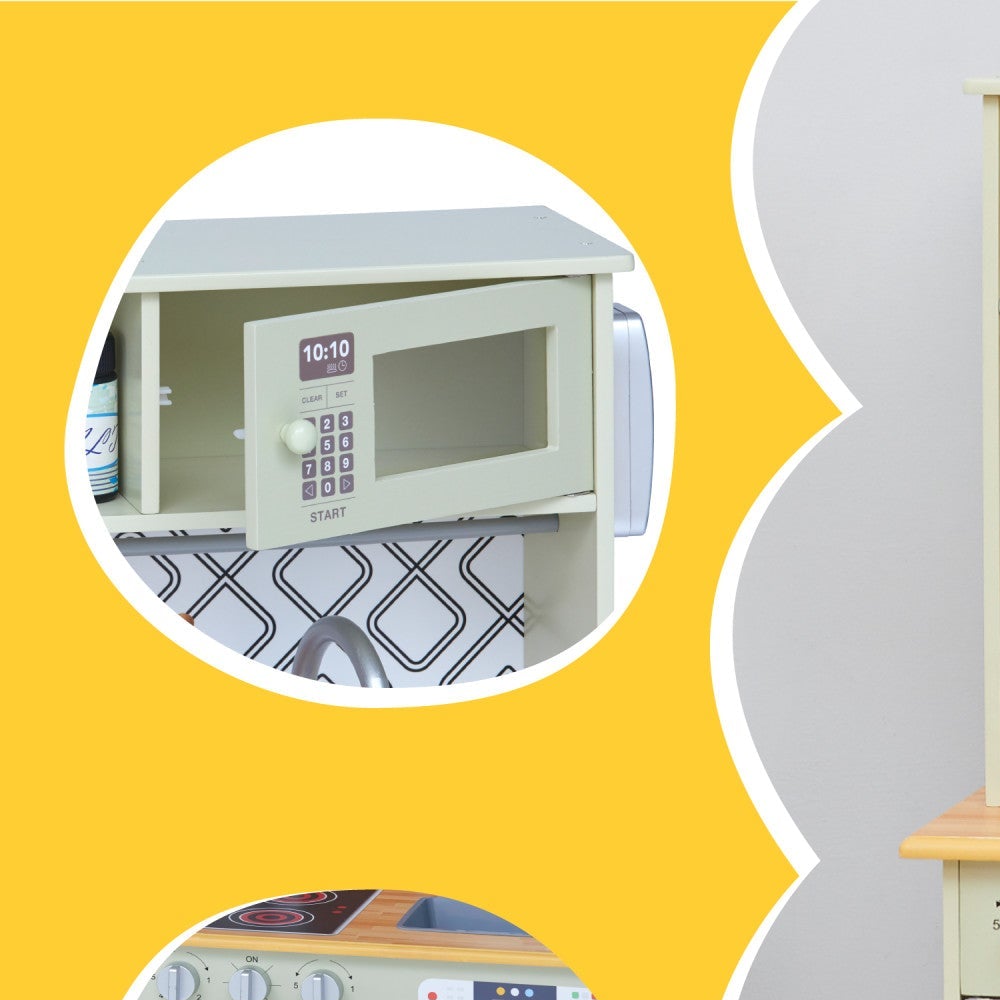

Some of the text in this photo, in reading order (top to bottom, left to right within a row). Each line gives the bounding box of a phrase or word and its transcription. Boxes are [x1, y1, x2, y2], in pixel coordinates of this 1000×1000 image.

[303, 339, 350, 363] 10:10
[302, 390, 348, 404] CLEAR SET
[324, 415, 349, 430] 2 3
[324, 436, 349, 451] 5 6
[306, 457, 350, 475] 7 8 9
[324, 482, 331, 493] 0
[310, 507, 347, 523] START
[993, 919, 1000, 931] 5
